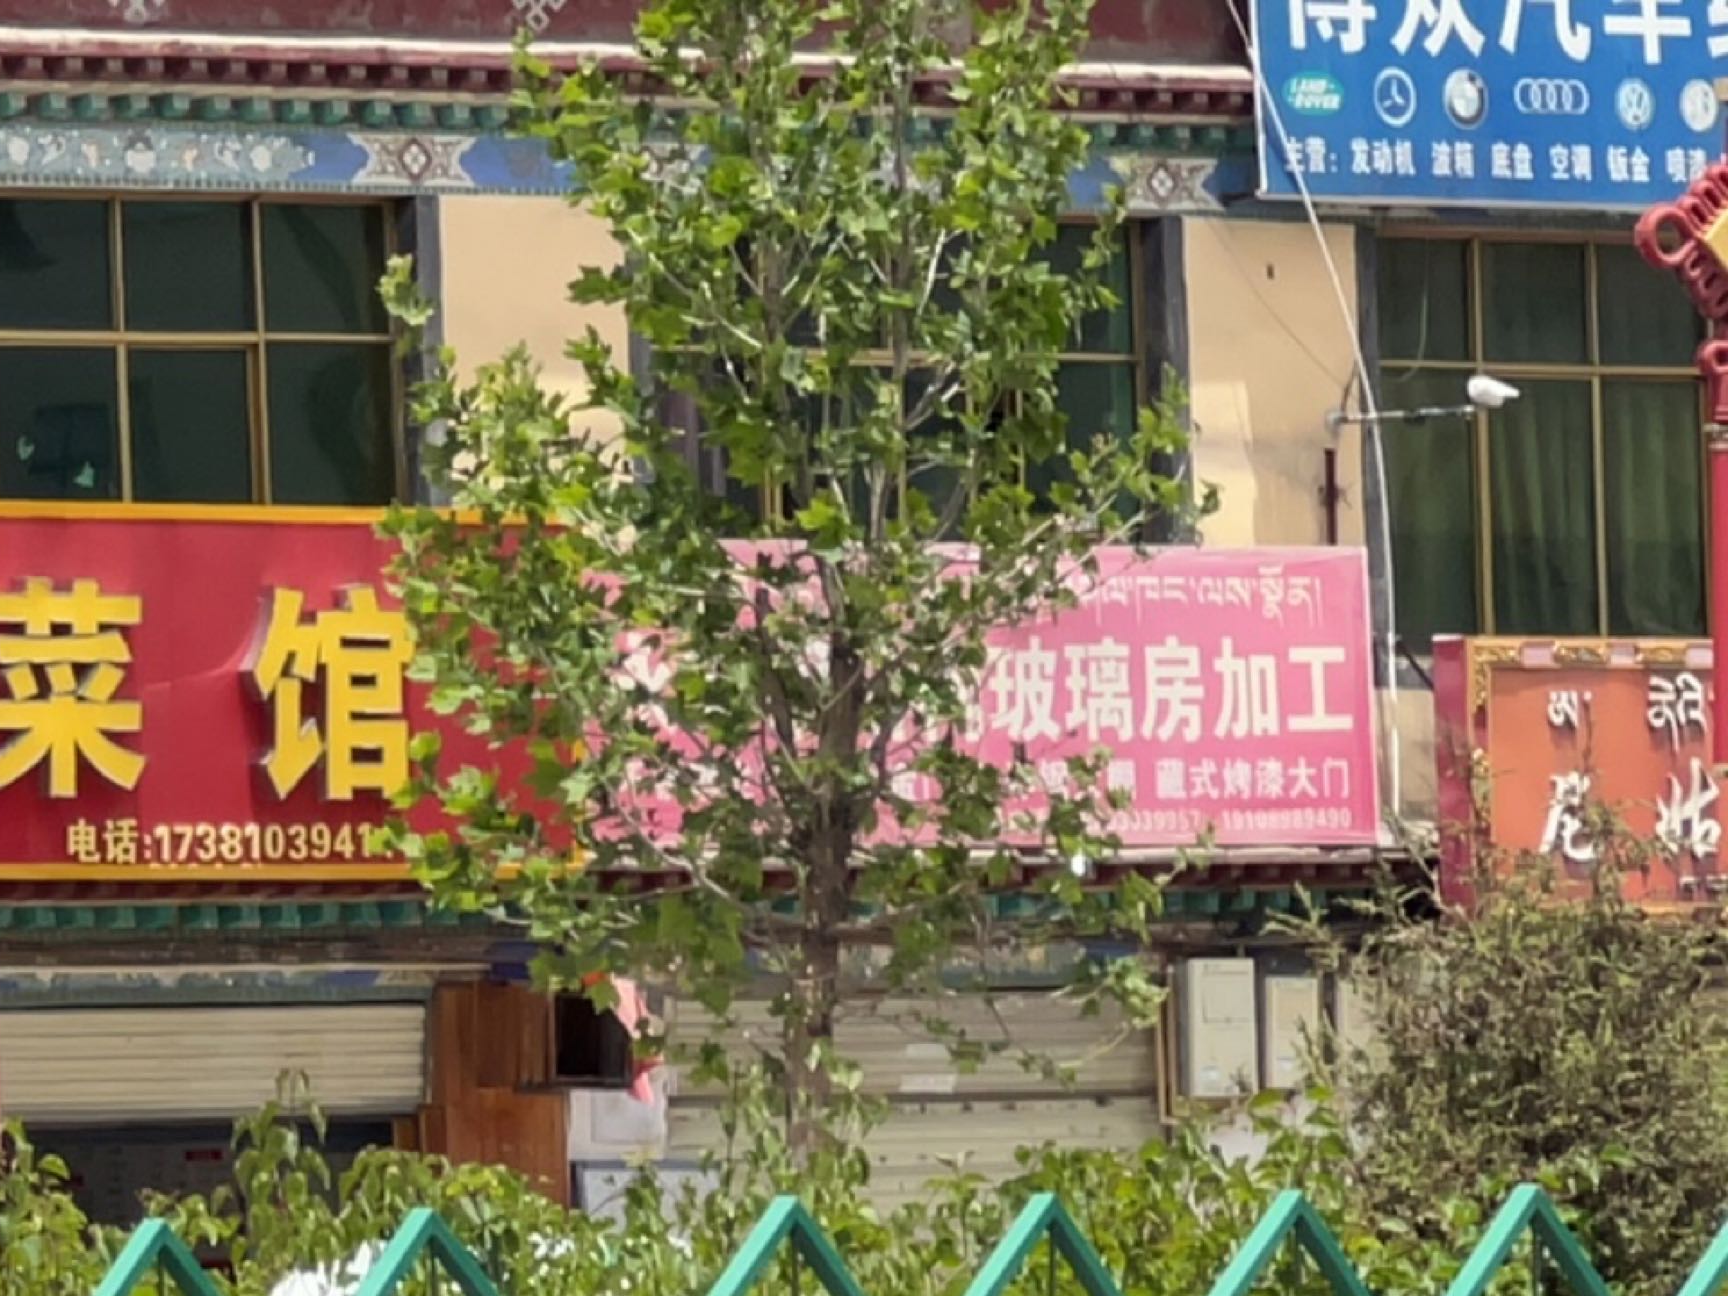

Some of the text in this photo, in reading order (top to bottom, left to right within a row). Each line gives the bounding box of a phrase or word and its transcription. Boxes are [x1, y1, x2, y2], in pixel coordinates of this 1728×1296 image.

[1351, 137, 1416, 175] 发动机
[1491, 142, 1534, 180] 底盘
[1549, 144, 1593, 181] 空调
[66, 818, 396, 865] 电话:1738103941
